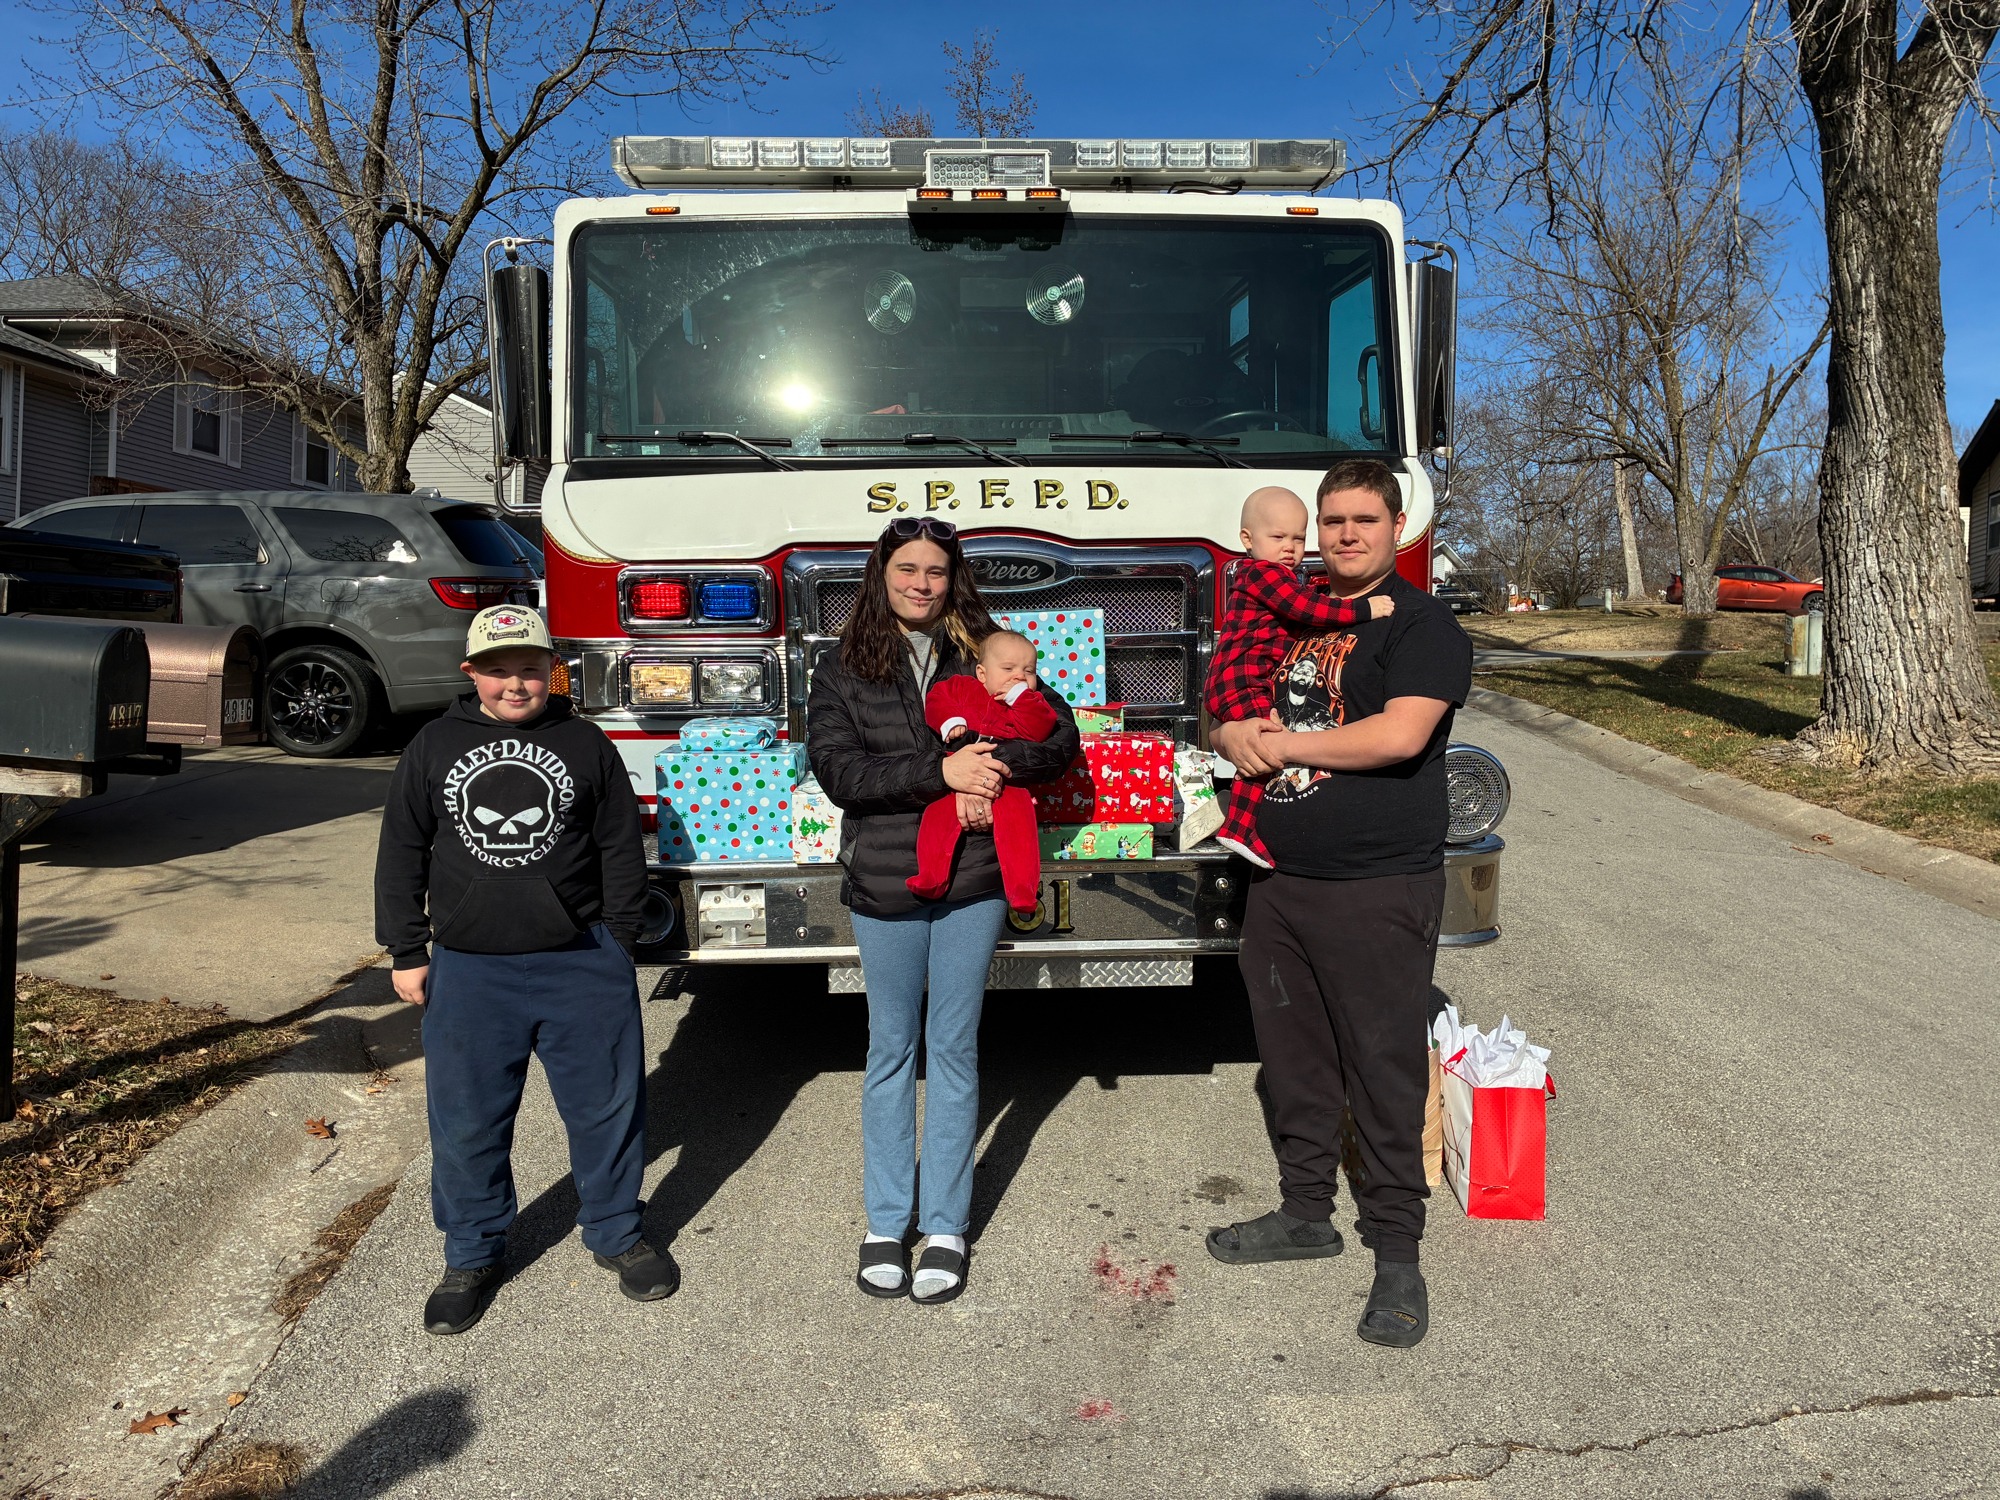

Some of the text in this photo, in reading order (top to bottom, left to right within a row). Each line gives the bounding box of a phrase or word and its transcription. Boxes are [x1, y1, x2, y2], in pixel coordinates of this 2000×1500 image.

[970, 558, 1041, 580] Pierce
[109, 704, 142, 729] 4817
[444, 739, 575, 813] HARLEY-DAVIDSON
[1297, 785, 1320, 800] TOUR
[455, 822, 565, 868] MOTORCYCLES
